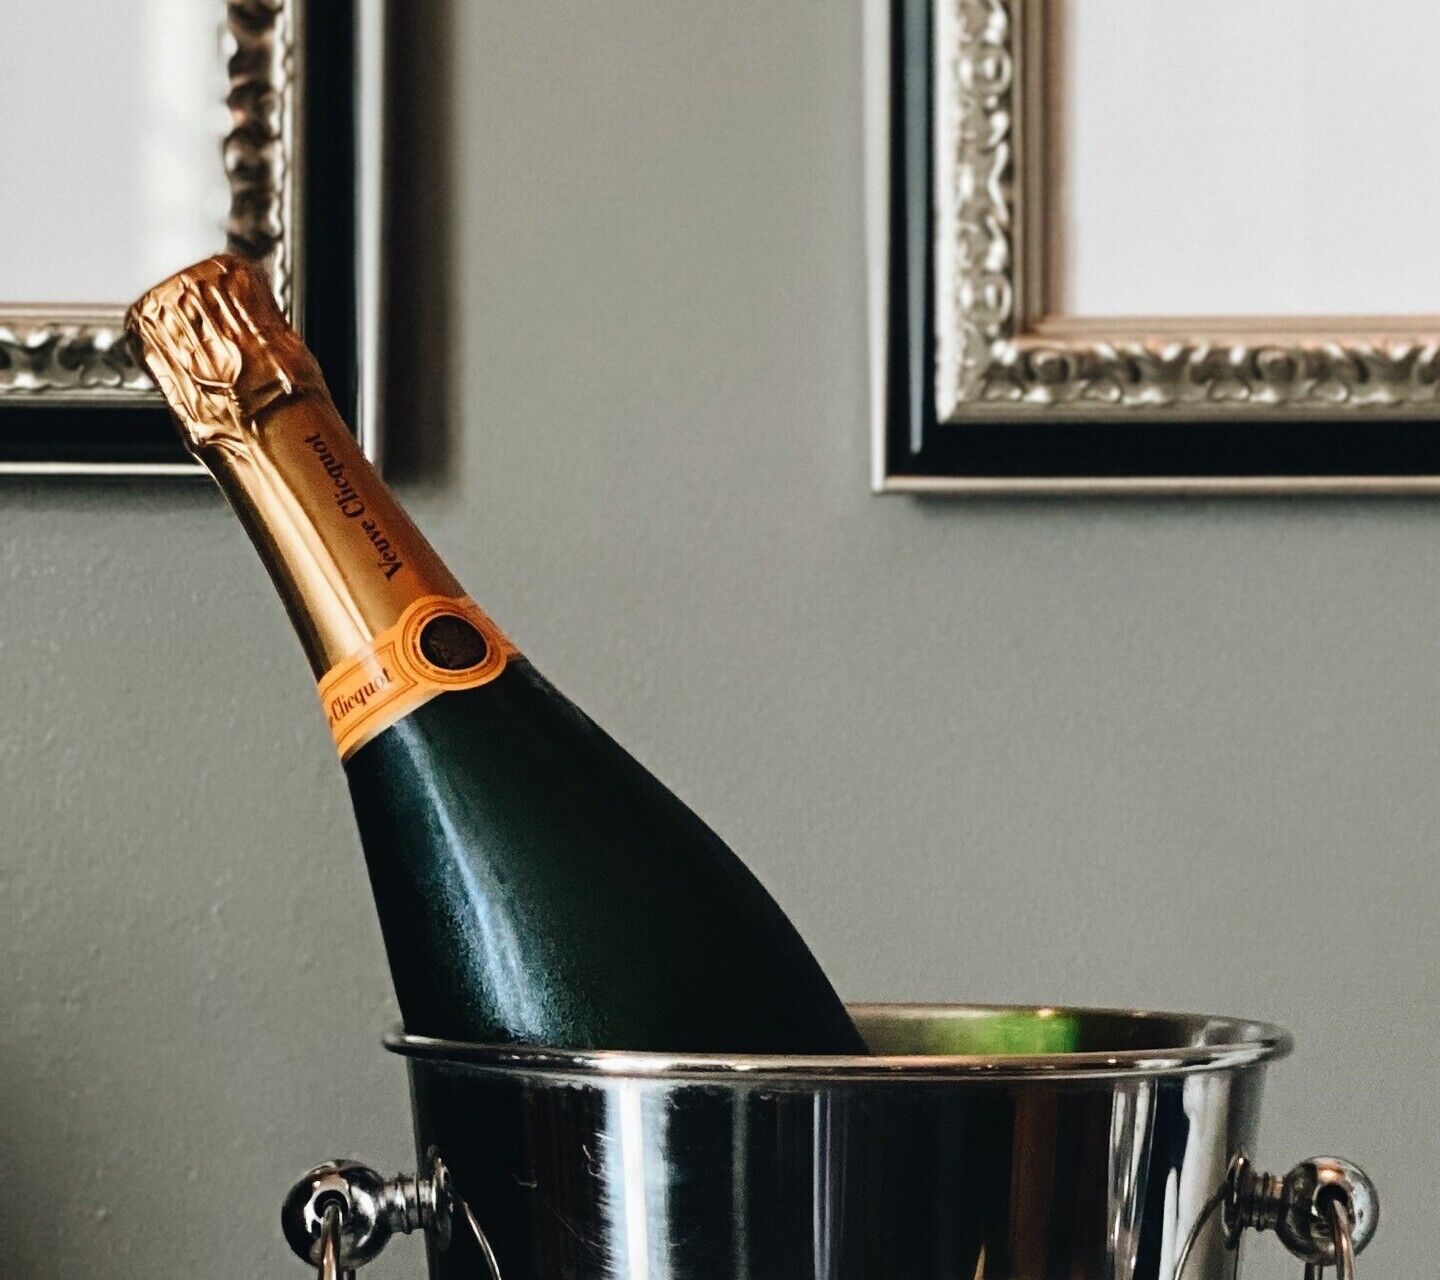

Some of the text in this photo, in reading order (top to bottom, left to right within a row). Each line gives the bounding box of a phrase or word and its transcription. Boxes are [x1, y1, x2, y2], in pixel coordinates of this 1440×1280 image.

[304, 432, 402, 581] Veuve Clicquot
[331, 666, 393, 722] Clicquot
